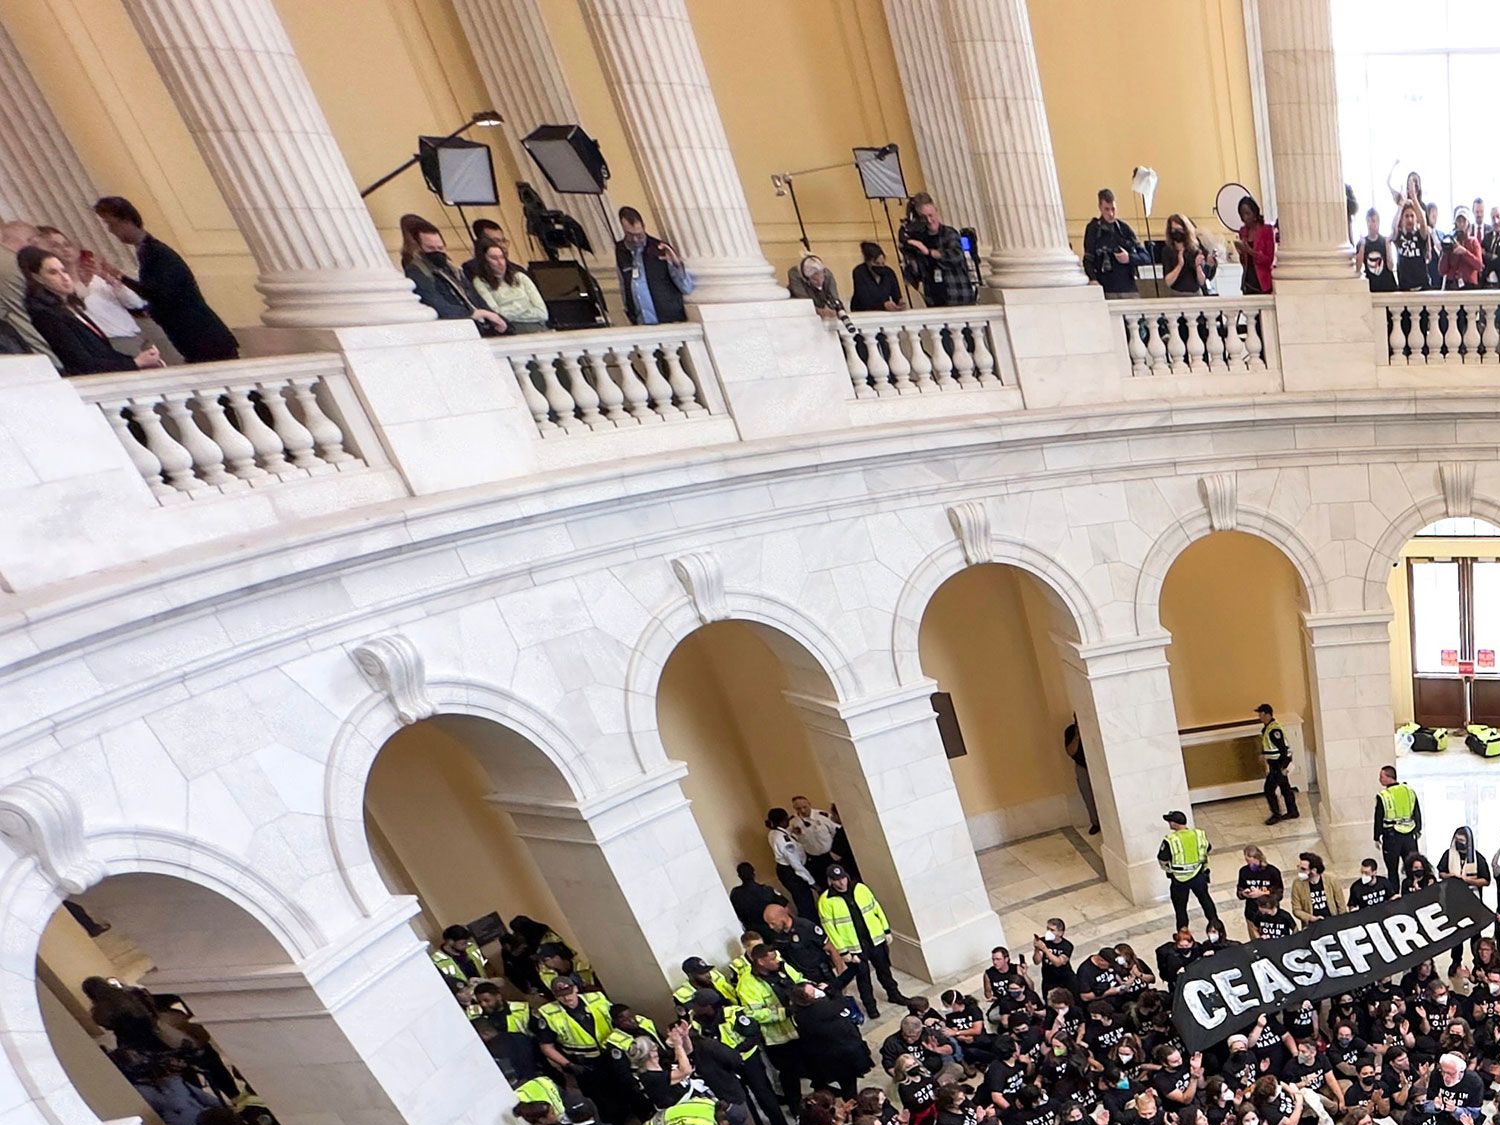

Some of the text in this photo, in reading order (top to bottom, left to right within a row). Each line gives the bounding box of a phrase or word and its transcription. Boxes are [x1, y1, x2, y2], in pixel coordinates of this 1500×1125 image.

[1182, 901, 1475, 1030] CEASEFIRE.
[1026, 1111, 1054, 1125] NOT IN
